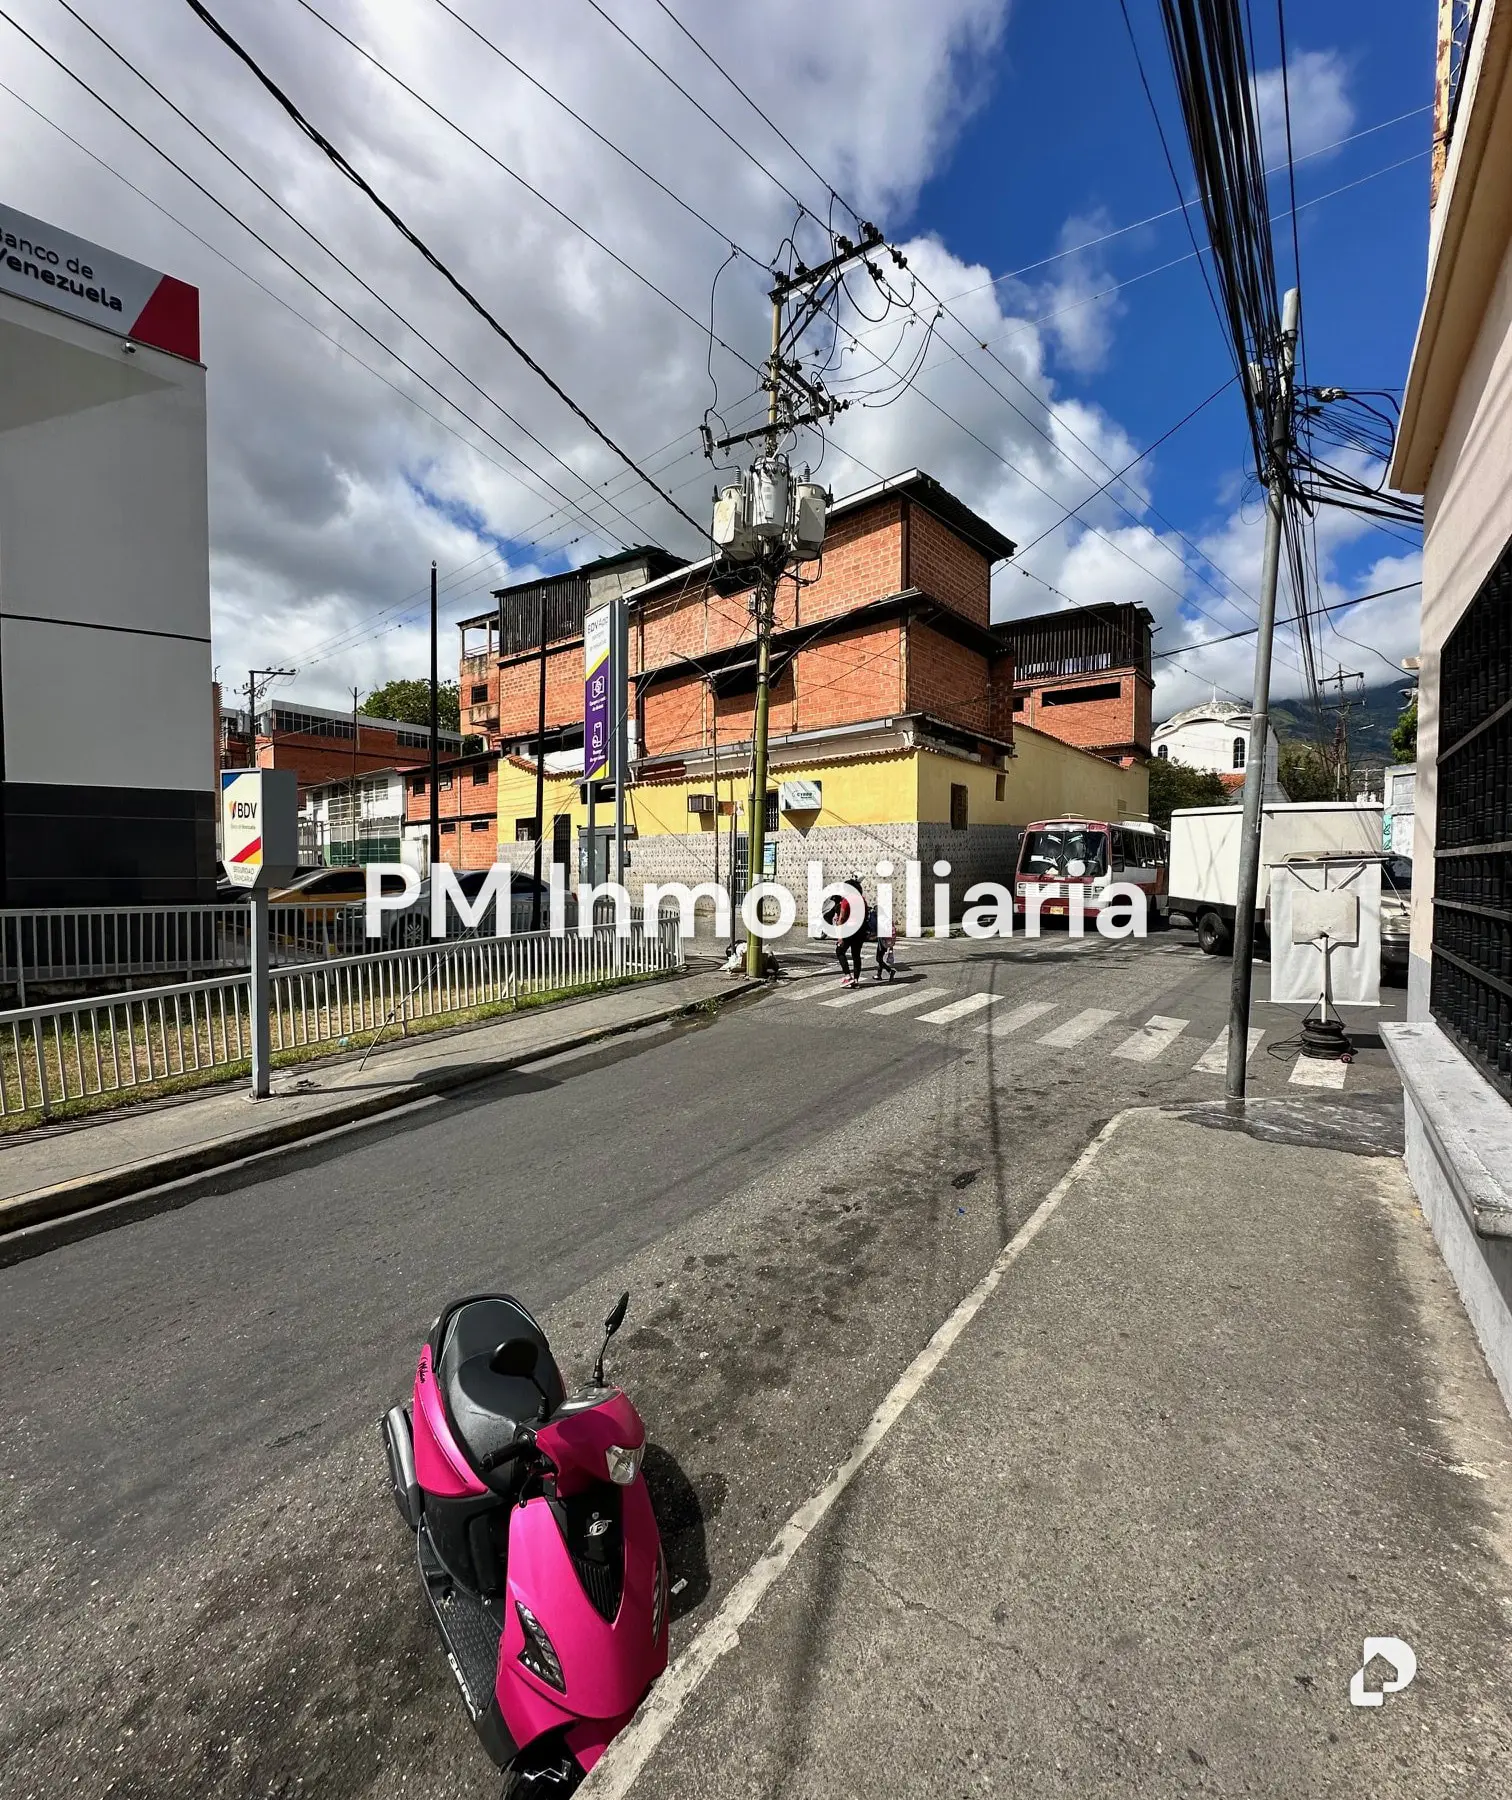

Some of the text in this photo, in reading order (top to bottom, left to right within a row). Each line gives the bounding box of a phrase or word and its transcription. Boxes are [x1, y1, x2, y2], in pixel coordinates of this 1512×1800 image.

[0, 227, 94, 280] anco de
[237, 802, 257, 819] BDV
